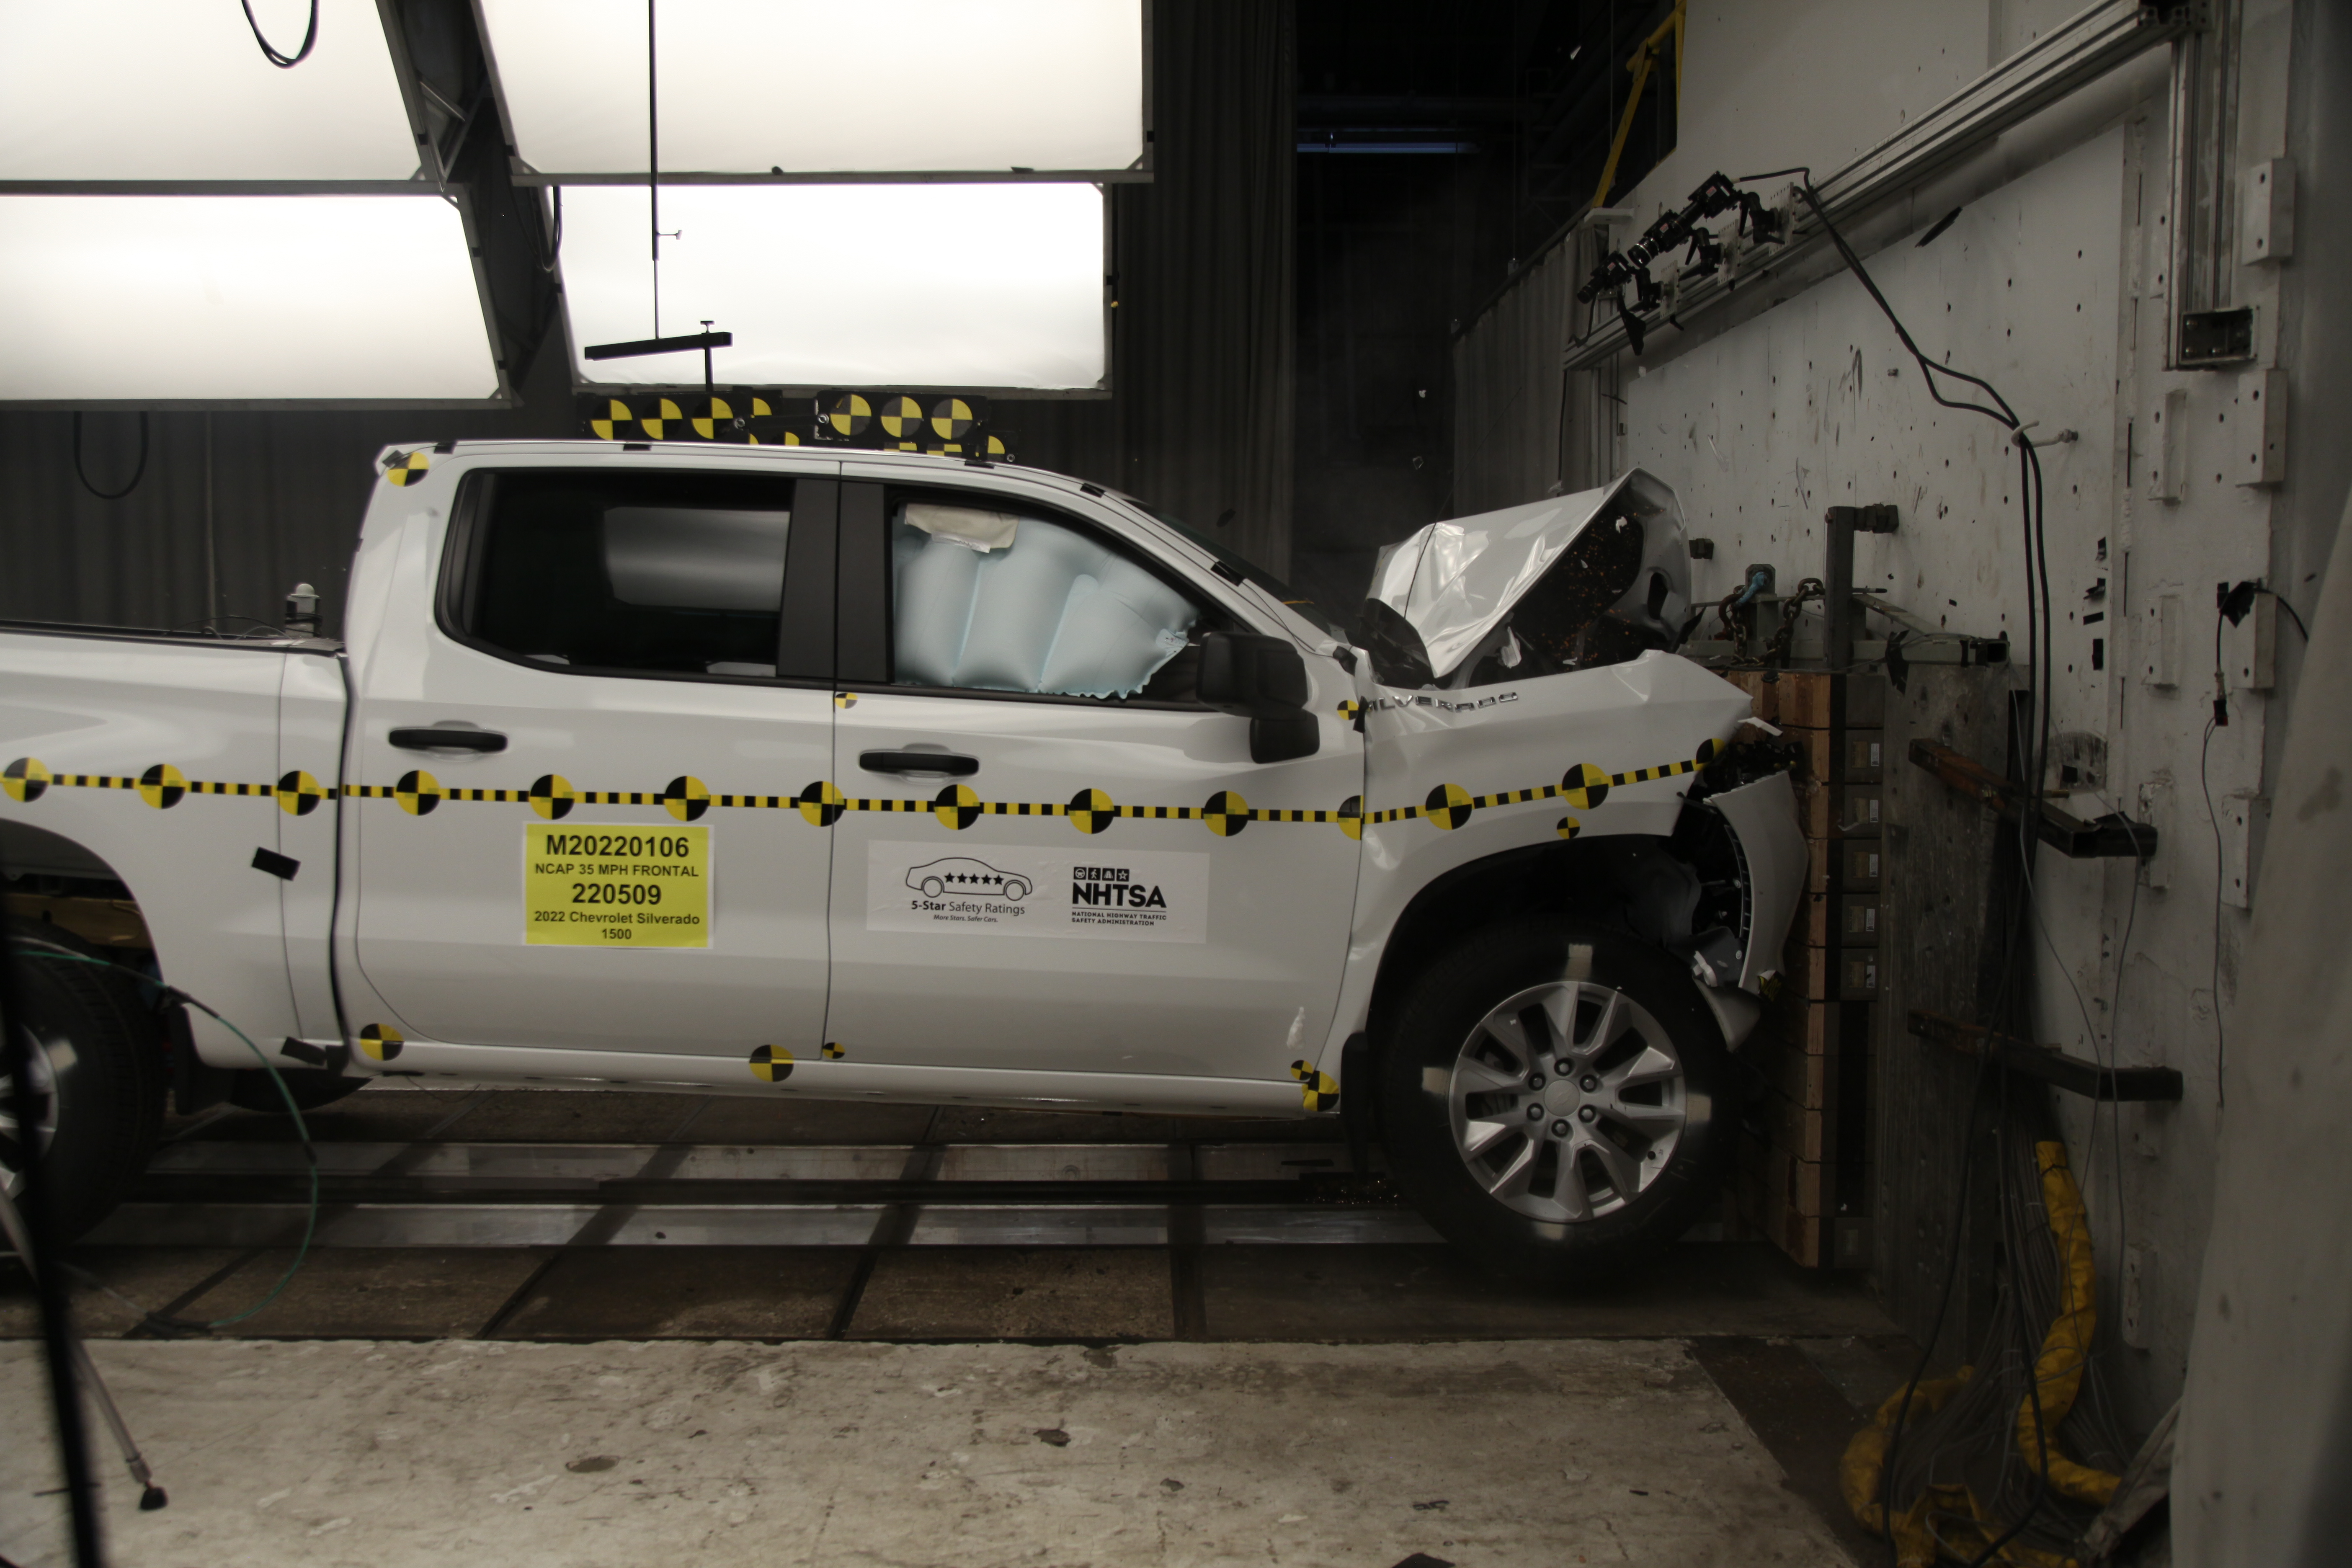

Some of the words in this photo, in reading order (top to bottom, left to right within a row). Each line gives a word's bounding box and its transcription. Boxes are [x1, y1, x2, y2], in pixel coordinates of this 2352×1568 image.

[1367, 692, 1518, 712] ILVERADO
[547, 834, 689, 858] M20220106
[535, 863, 574, 874] NCAP
[579, 864, 594, 875] 35
[598, 864, 628, 875] MPH
[633, 865, 699, 877] FRONTAL
[572, 883, 661, 905] 220509
[1072, 882, 1167, 908] NHTSA
[911, 900, 946, 911] 5-Star
[949, 901, 983, 915] Safety
[985, 903, 1025, 917] Ratings
[534, 911, 565, 922] 2022
[570, 911, 633, 924] Chevrolet
[637, 913, 700, 925] Silverado
[602, 928, 632, 940] 1500
